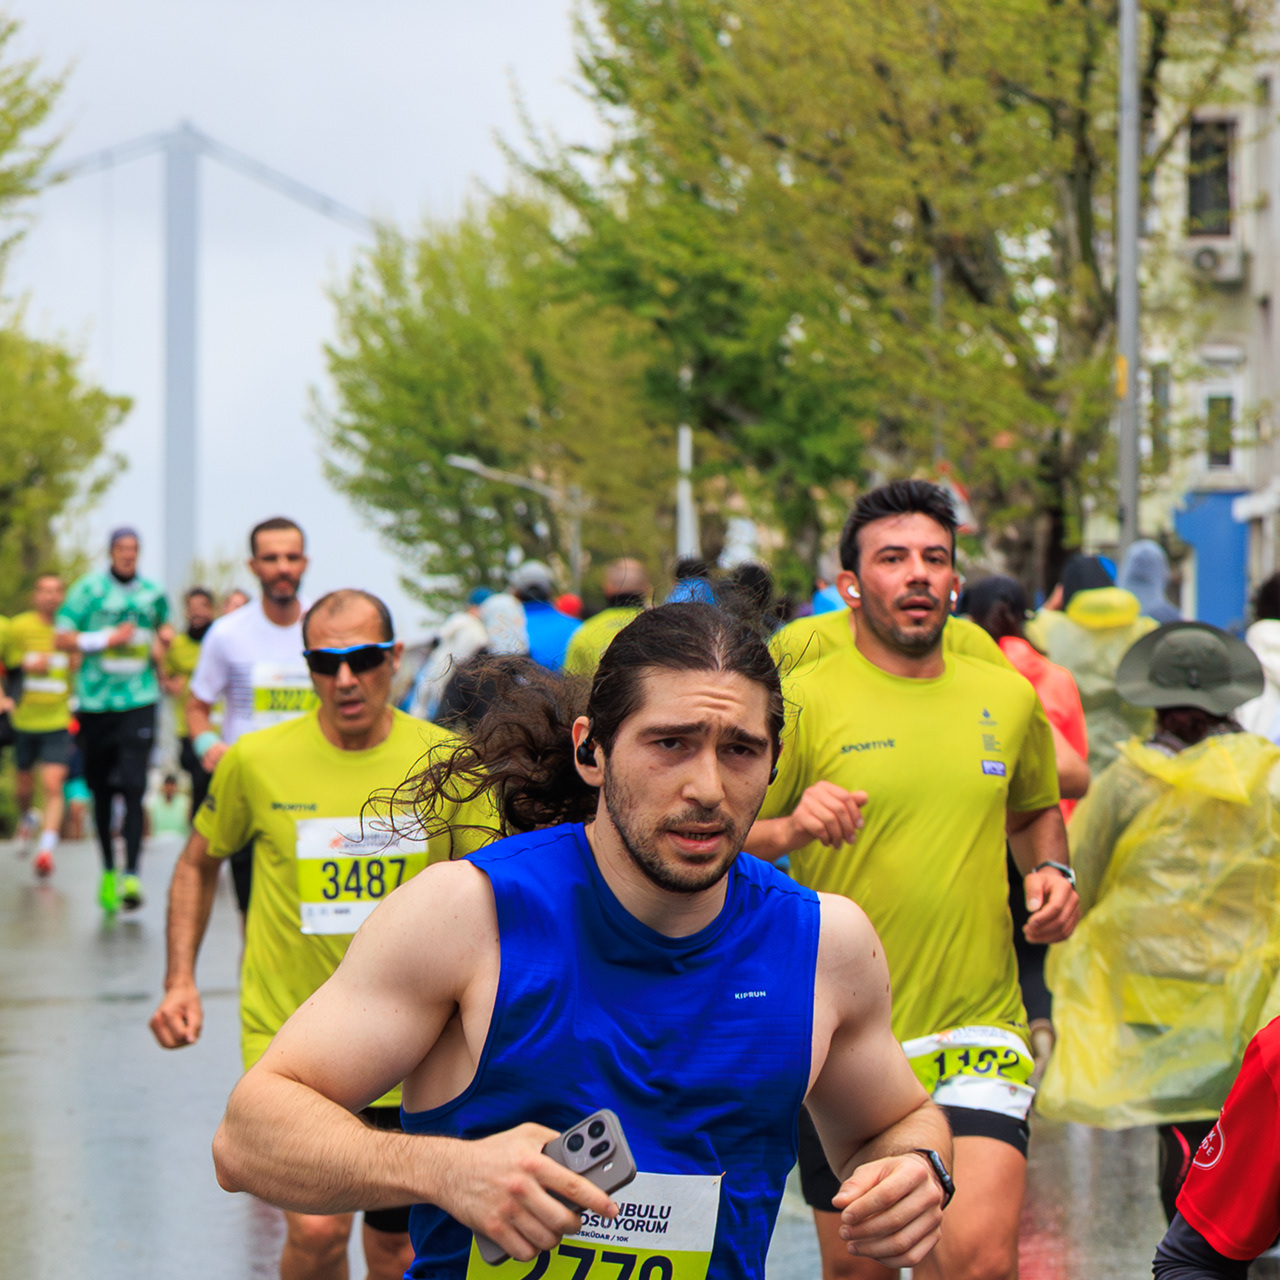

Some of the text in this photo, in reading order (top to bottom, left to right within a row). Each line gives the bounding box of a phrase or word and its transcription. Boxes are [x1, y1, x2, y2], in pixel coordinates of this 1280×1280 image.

[322, 859, 406, 900] 3487
[734, 990, 767, 1000] KIPRUN
[614, 1202, 672, 1220] NBULU
[579, 1213, 669, 1233] OSUYORUM
